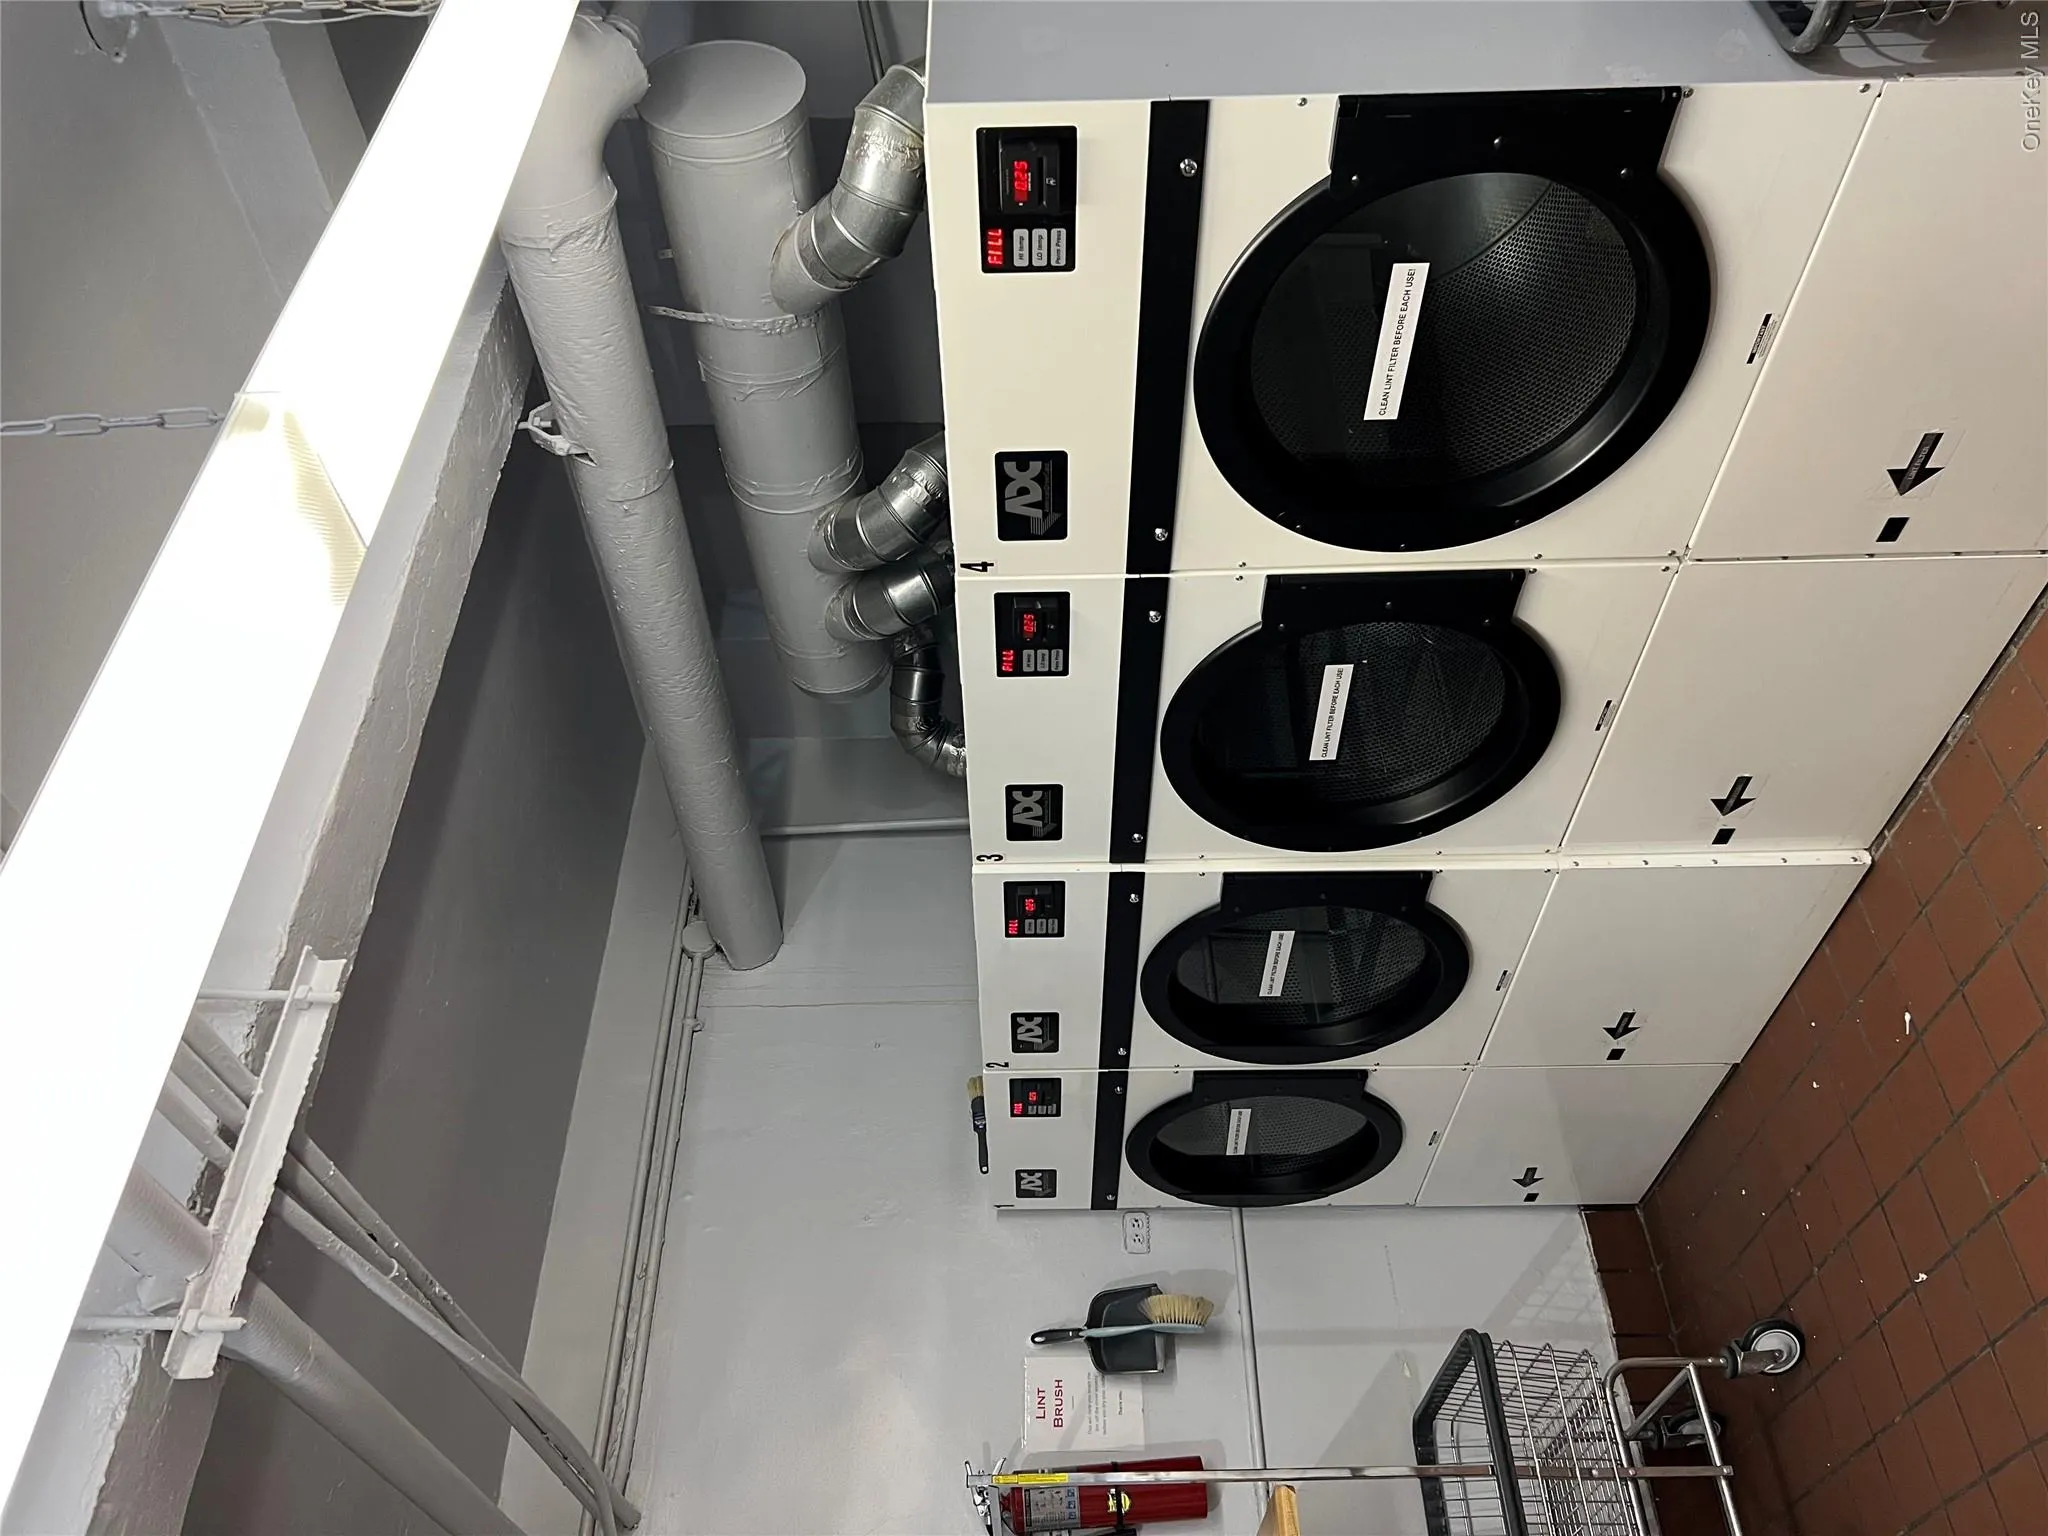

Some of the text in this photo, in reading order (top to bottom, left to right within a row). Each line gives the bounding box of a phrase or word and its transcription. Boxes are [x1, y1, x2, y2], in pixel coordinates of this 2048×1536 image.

[988, 228, 1003, 265] FILL
[1379, 268, 1416, 416] CLEAN LINT FILTER BEFORE EACH USE!
[1003, 461, 1042, 519] ADC
[960, 562, 994, 572] 4
[1002, 650, 1013, 672] FILL
[1329, 695, 1338, 714] BEFORE
[1326, 715, 1334, 730] FILTER
[1321, 743, 1329, 758] CLEAN
[1012, 791, 1042, 827] ADC
[1017, 1017, 1042, 1043] ADC
[1036, 1388, 1046, 1419] LINT
[1053, 1379, 1063, 1428] BRUSH
